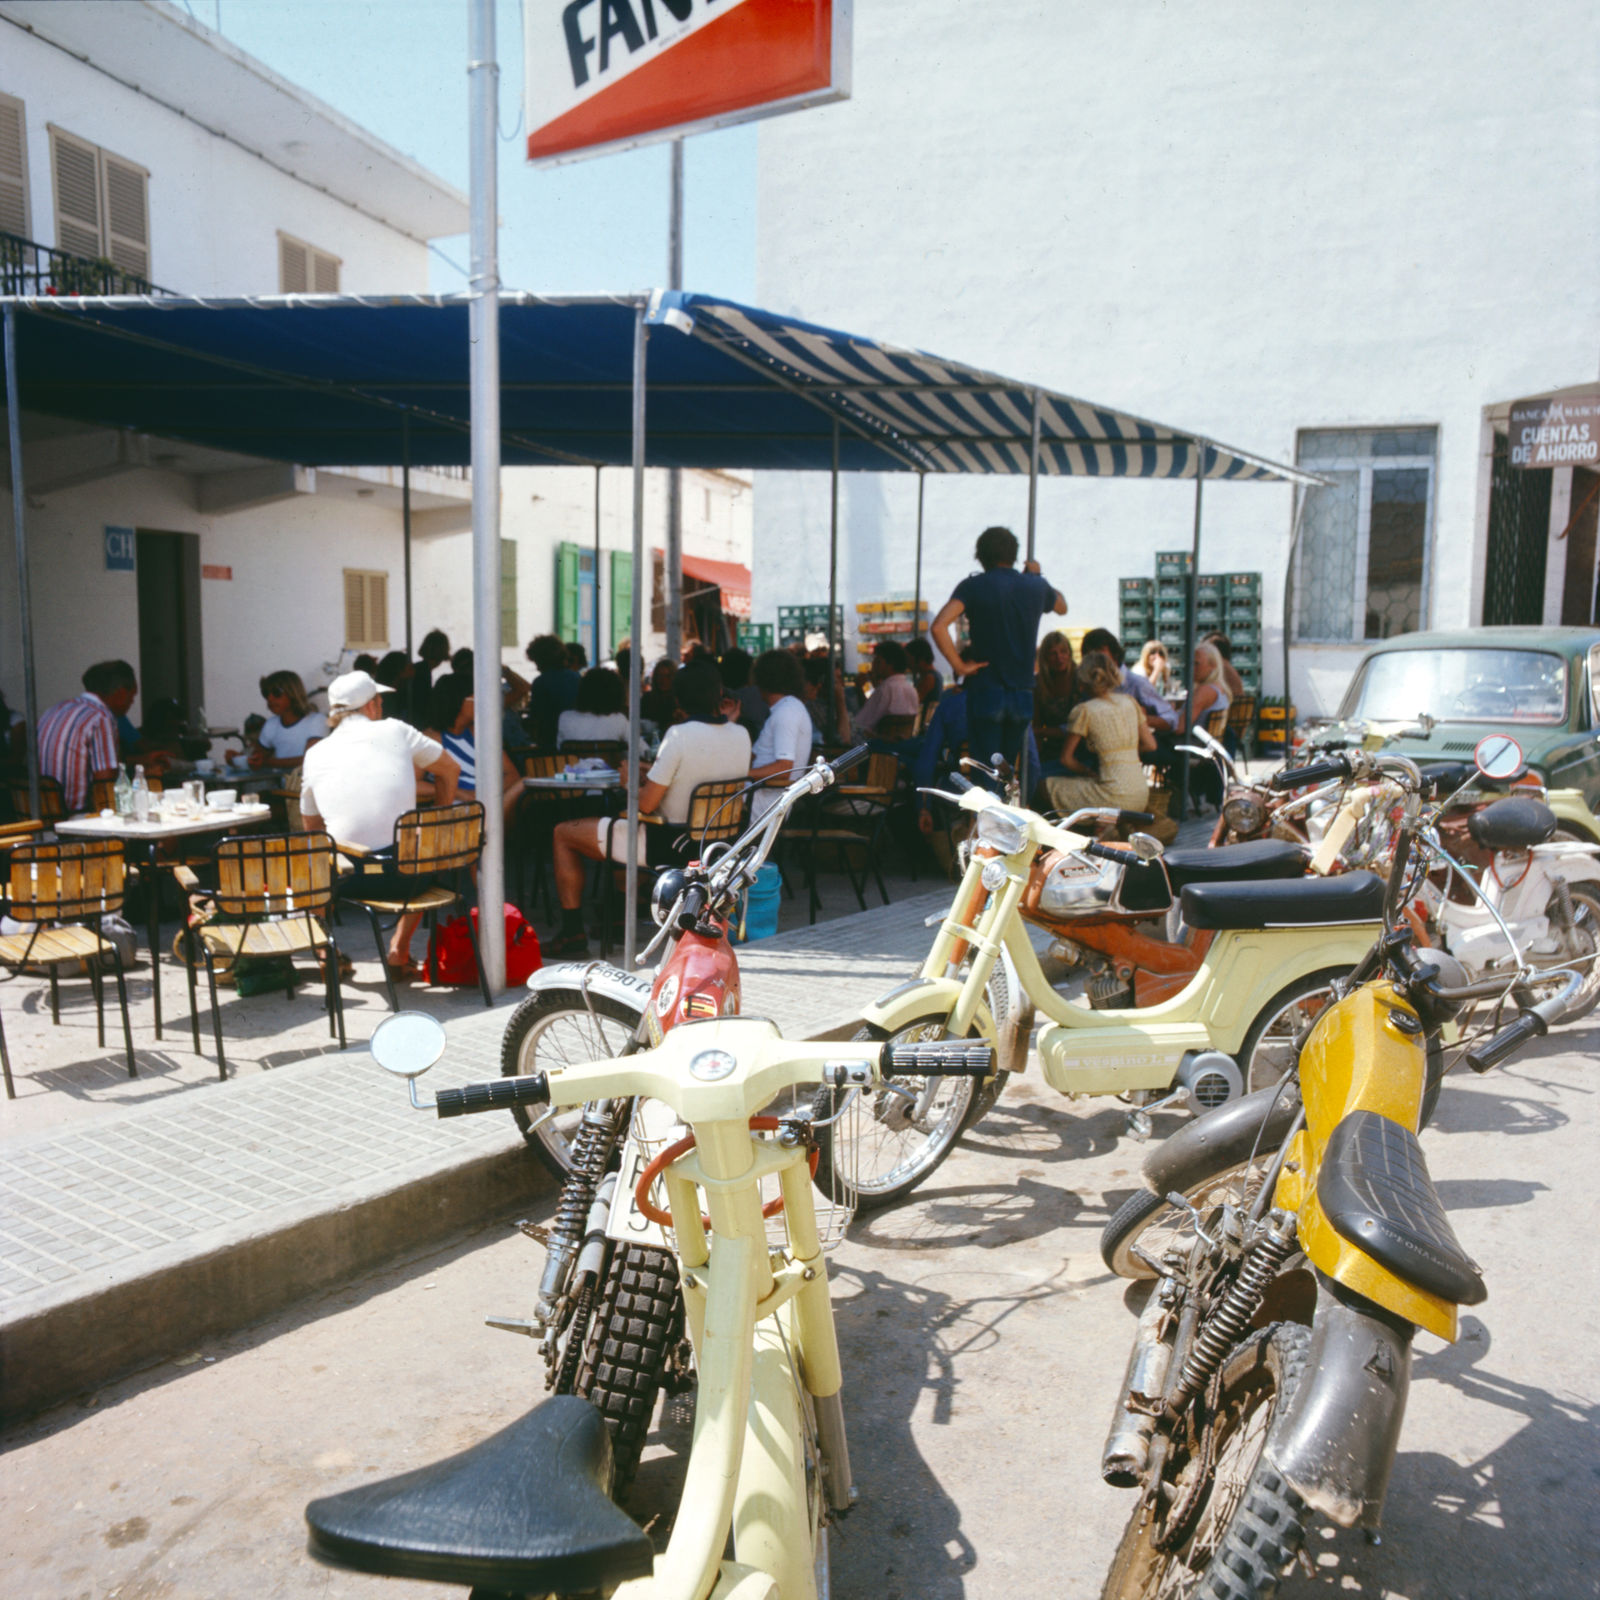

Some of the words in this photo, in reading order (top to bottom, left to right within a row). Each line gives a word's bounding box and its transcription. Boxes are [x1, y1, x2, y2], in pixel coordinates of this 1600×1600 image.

[1521, 423, 1589, 444] CUENTAS
[1511, 445, 1531, 464] DE
[1536, 441, 1597, 462] AHORRO
[106, 532, 133, 559] CH
